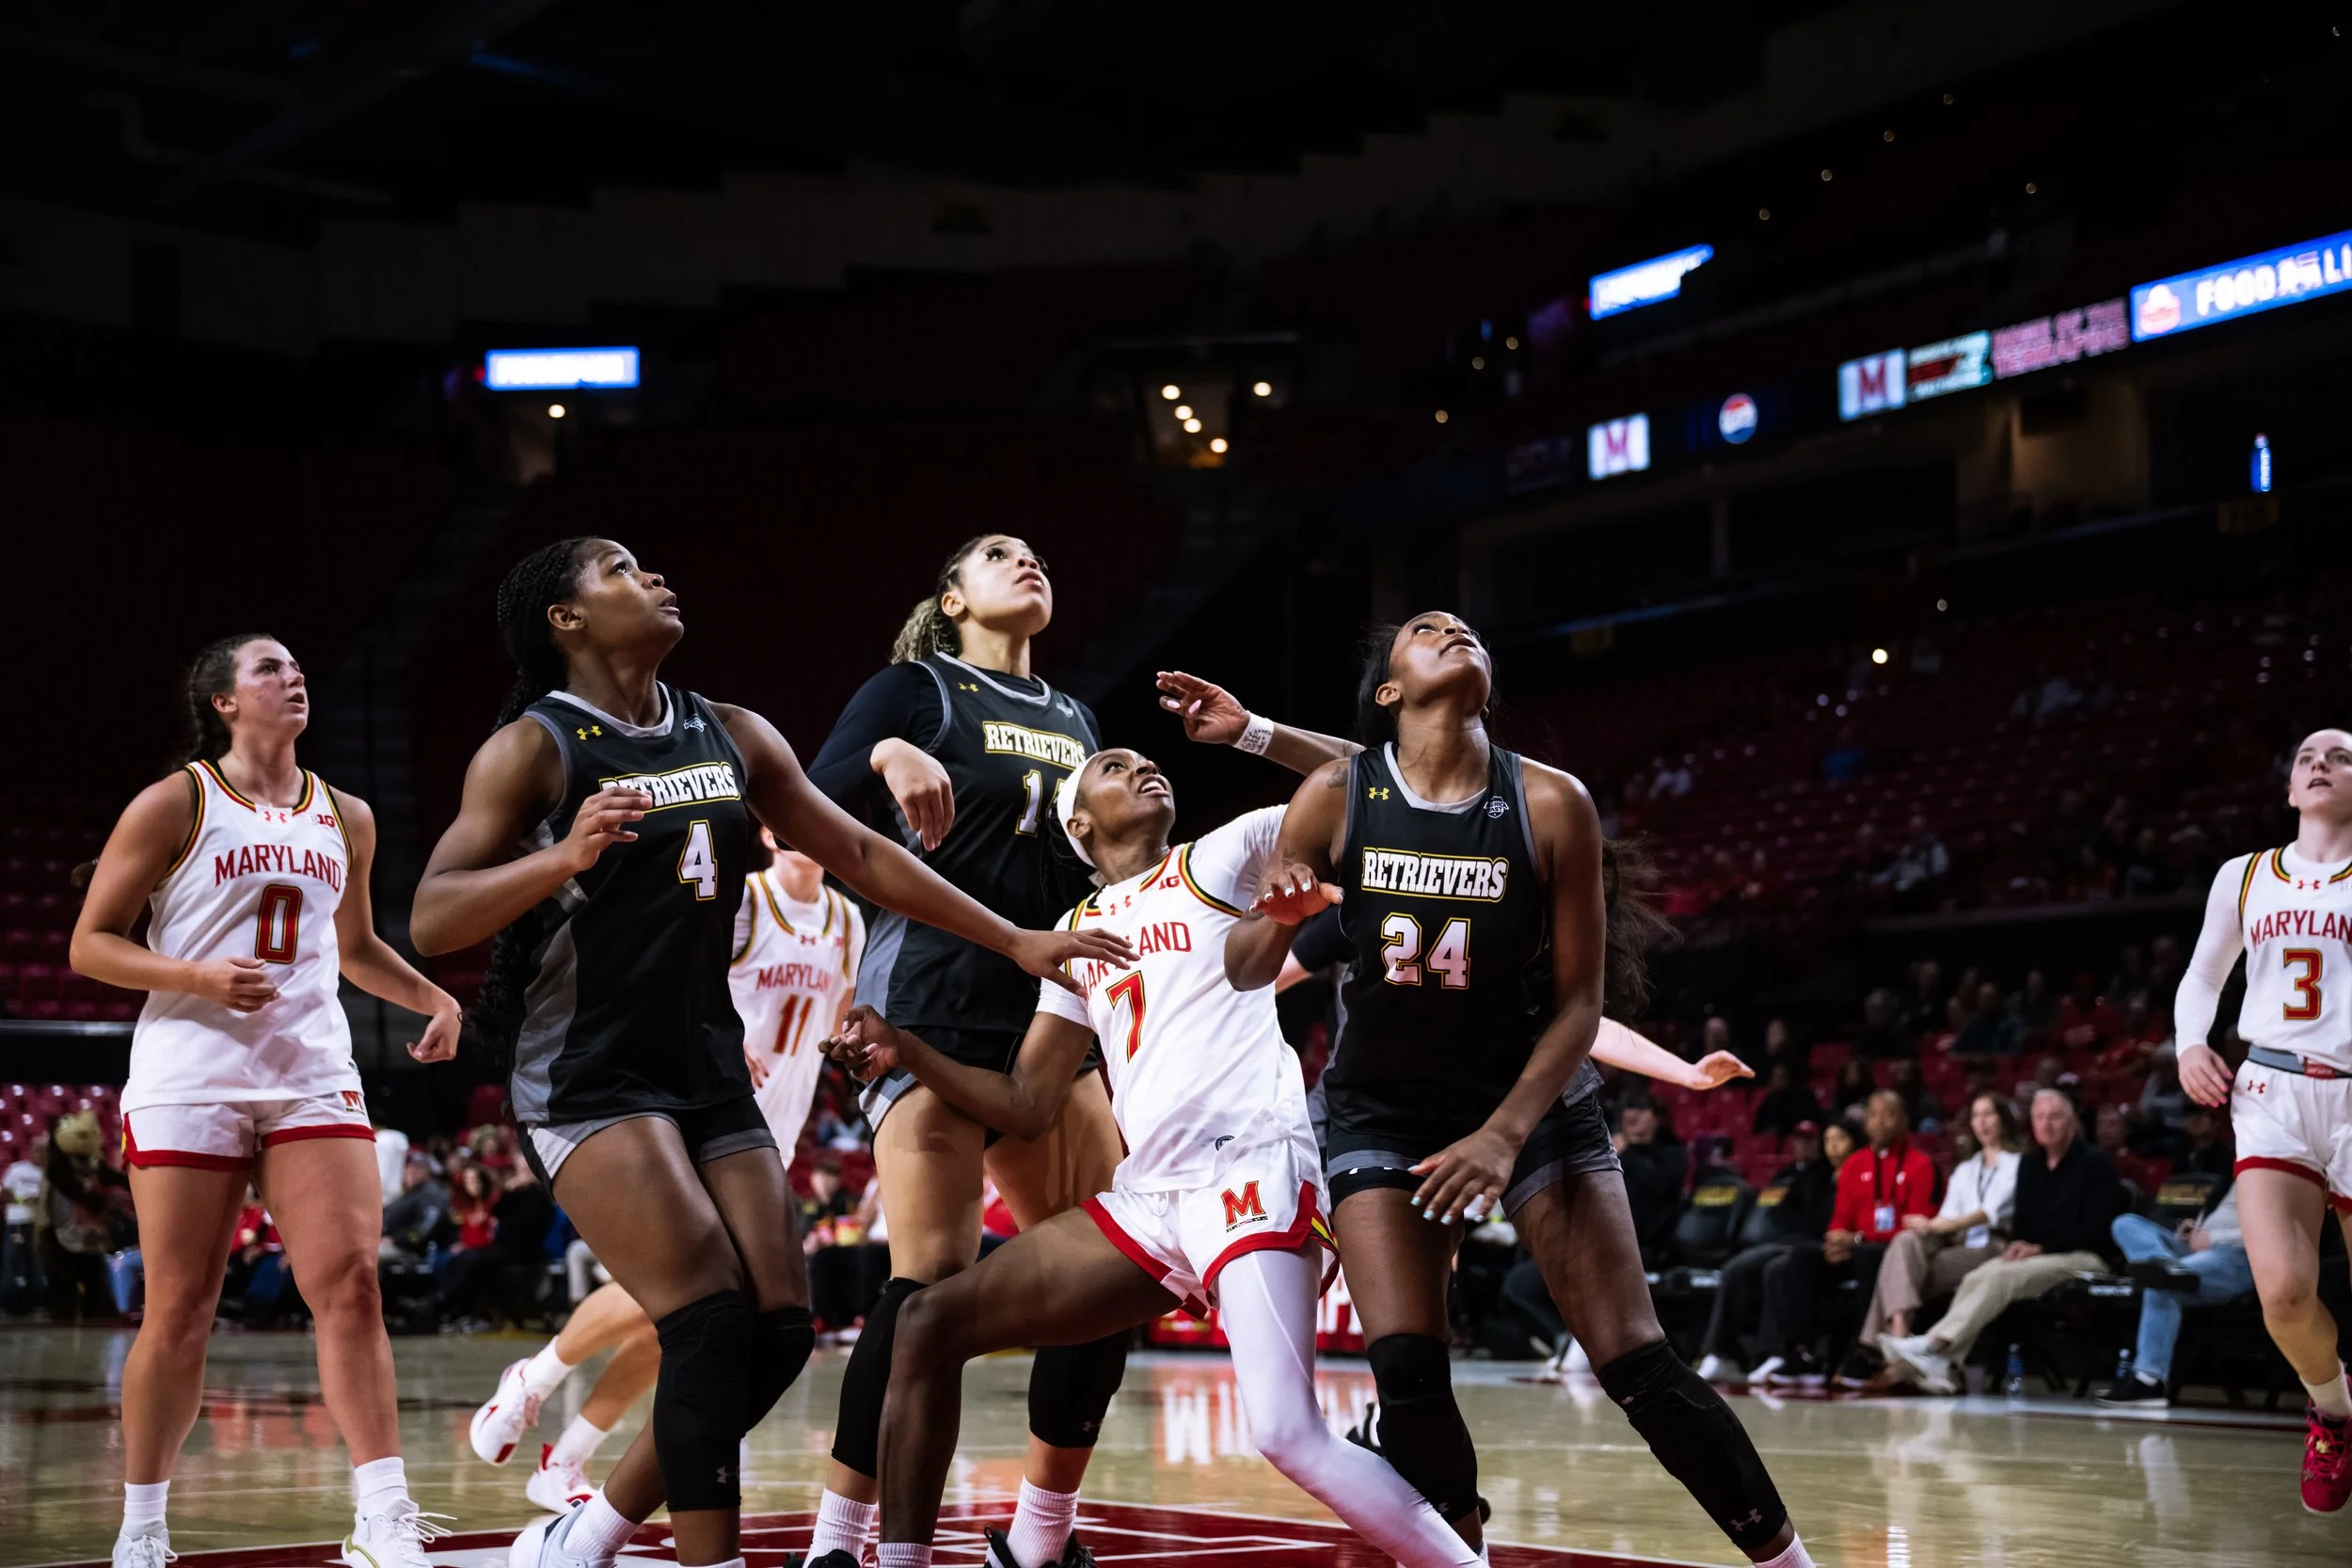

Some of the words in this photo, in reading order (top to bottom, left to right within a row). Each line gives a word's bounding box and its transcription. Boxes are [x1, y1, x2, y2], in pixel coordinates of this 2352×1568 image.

[2196, 264, 2276, 317] FOOD
[1857, 357, 1888, 404] M
[983, 721, 1087, 771] RETRIEVERS
[599, 762, 740, 813] TRIEVERS
[215, 844, 342, 894] MARYLAND
[676, 819, 718, 901] 4
[1361, 847, 1509, 903] RETRIEVERS
[255, 884, 303, 964] 0
[1381, 911, 1470, 990] 24
[2283, 948, 2323, 1021] 3
[772, 992, 814, 1057] 11
[1105, 970, 1146, 1064] 7
[1220, 1180, 1266, 1228] M
